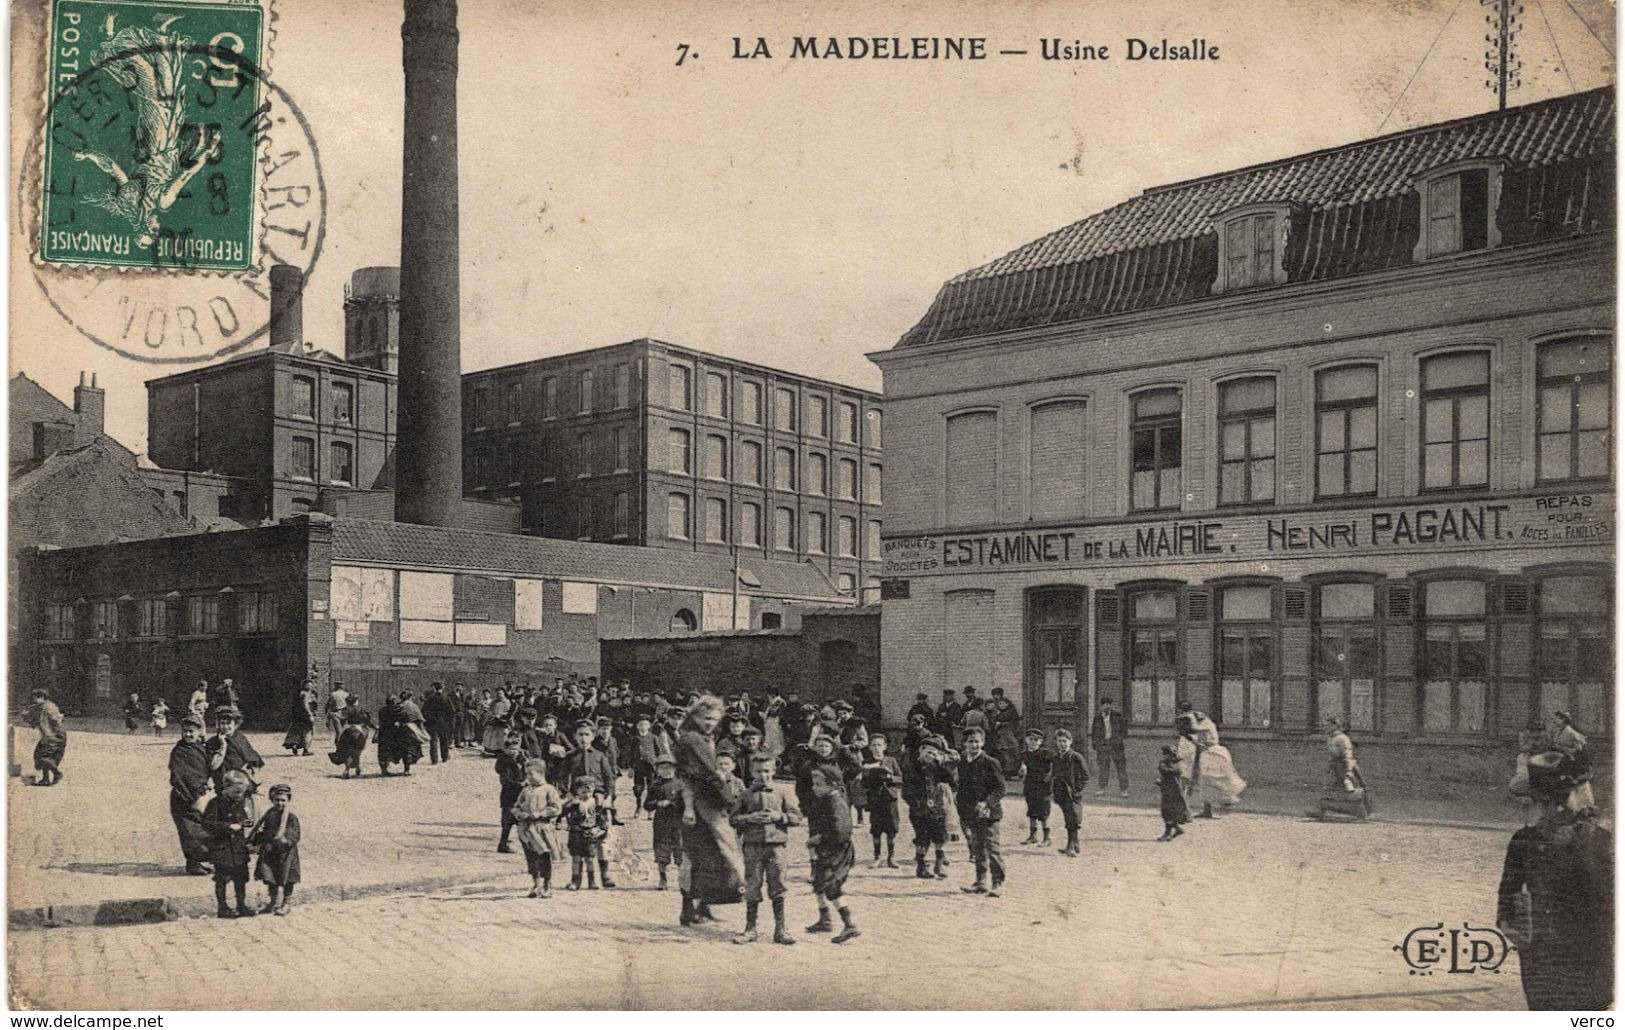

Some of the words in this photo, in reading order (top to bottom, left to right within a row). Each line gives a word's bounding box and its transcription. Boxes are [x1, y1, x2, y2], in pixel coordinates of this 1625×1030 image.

[51, 229, 130, 256] FRANÇAISE
[1536, 495, 1592, 510] REPAS
[1548, 512, 1582, 523] POUR
[885, 538, 937, 552] BANQUETS
[943, 531, 1075, 566] ESTAMINET
[1084, 542, 1102, 559] DE
[1109, 540, 1129, 559] LA
